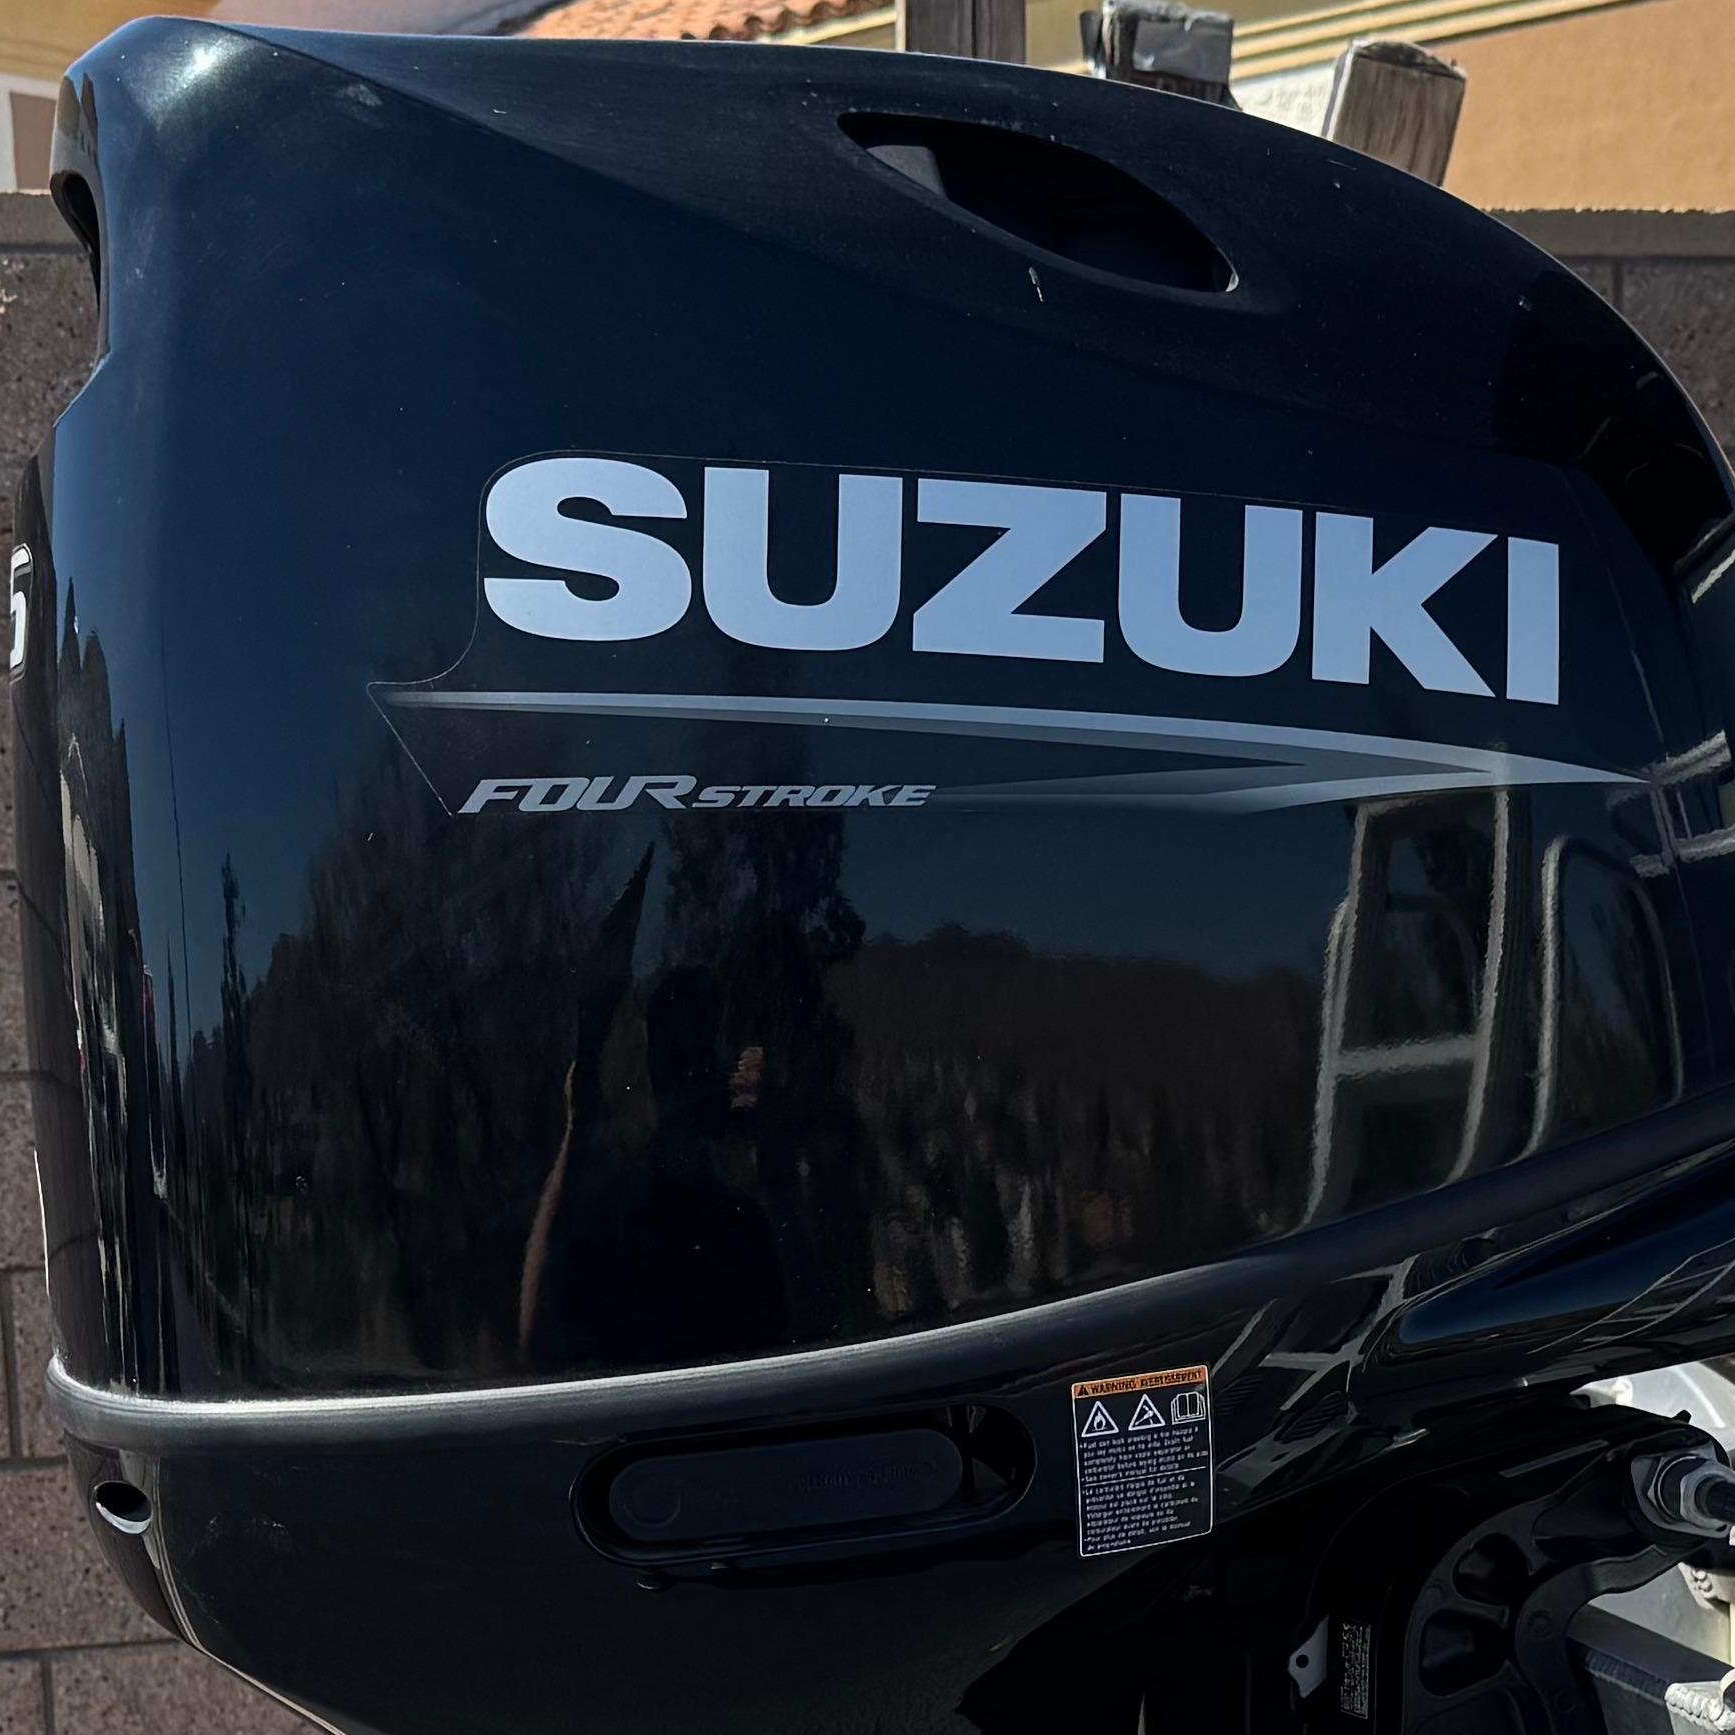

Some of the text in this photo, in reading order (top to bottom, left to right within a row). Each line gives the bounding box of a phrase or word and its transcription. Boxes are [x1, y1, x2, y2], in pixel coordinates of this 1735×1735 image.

[483, 456, 1561, 706] SUZUKI
[457, 774, 937, 815] FOUR STROKE
